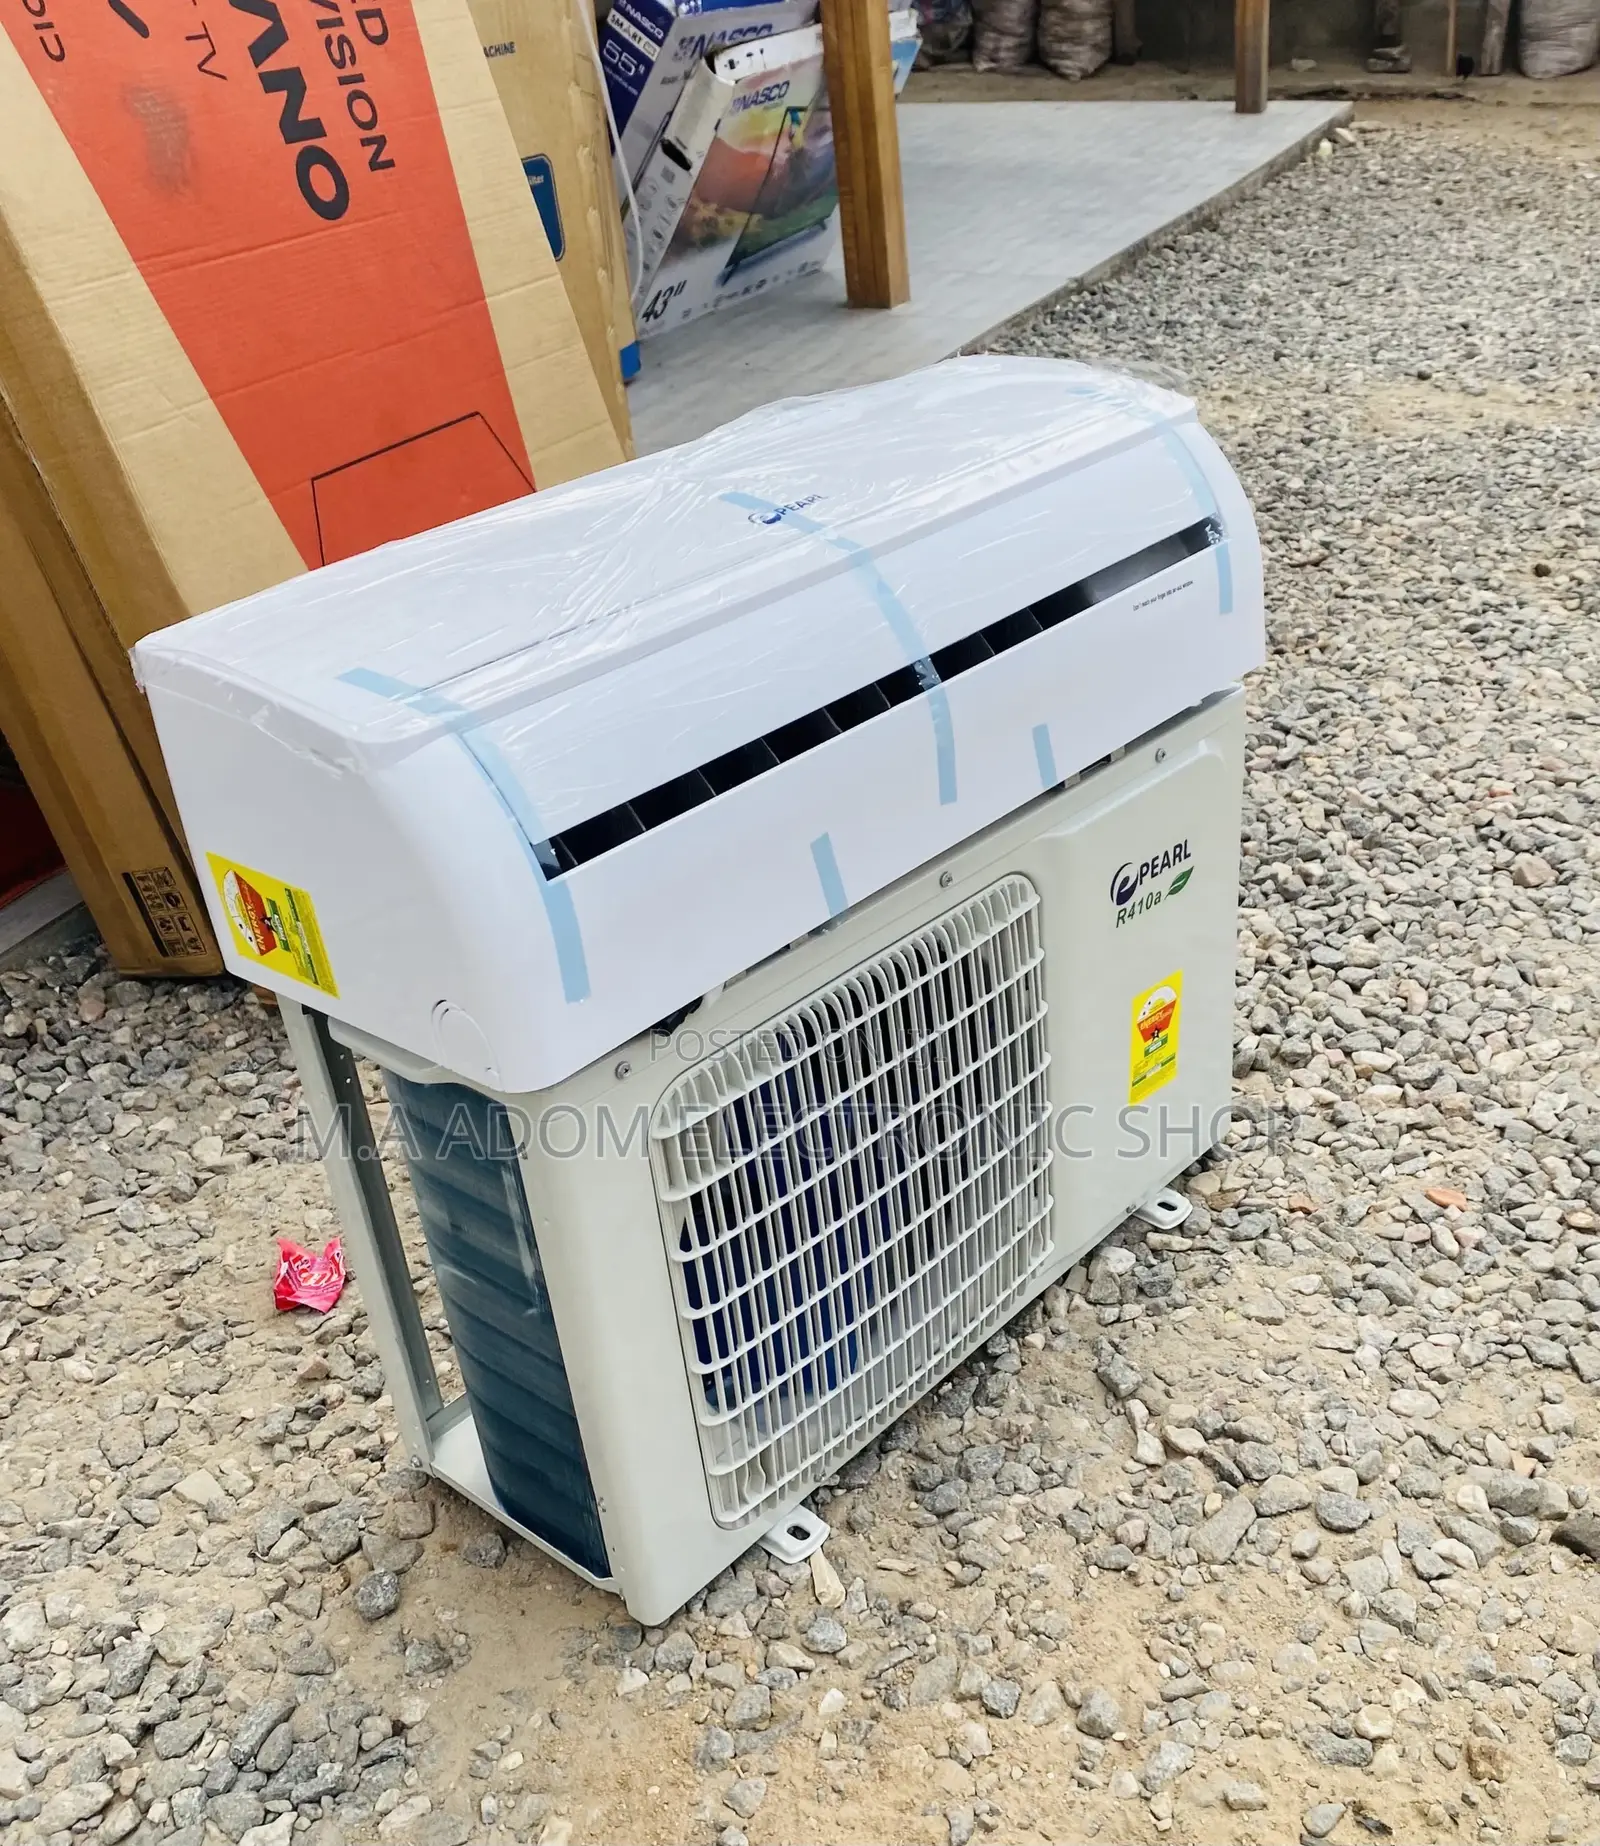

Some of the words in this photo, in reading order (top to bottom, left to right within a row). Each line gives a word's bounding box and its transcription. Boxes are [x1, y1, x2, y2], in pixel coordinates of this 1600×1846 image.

[624, 3, 664, 40] NASCO
[185, 20, 228, 81] TV
[741, 79, 790, 110] NASCO
[1138, 838, 1192, 886] PEARL
[1115, 890, 1163, 929] R410a
